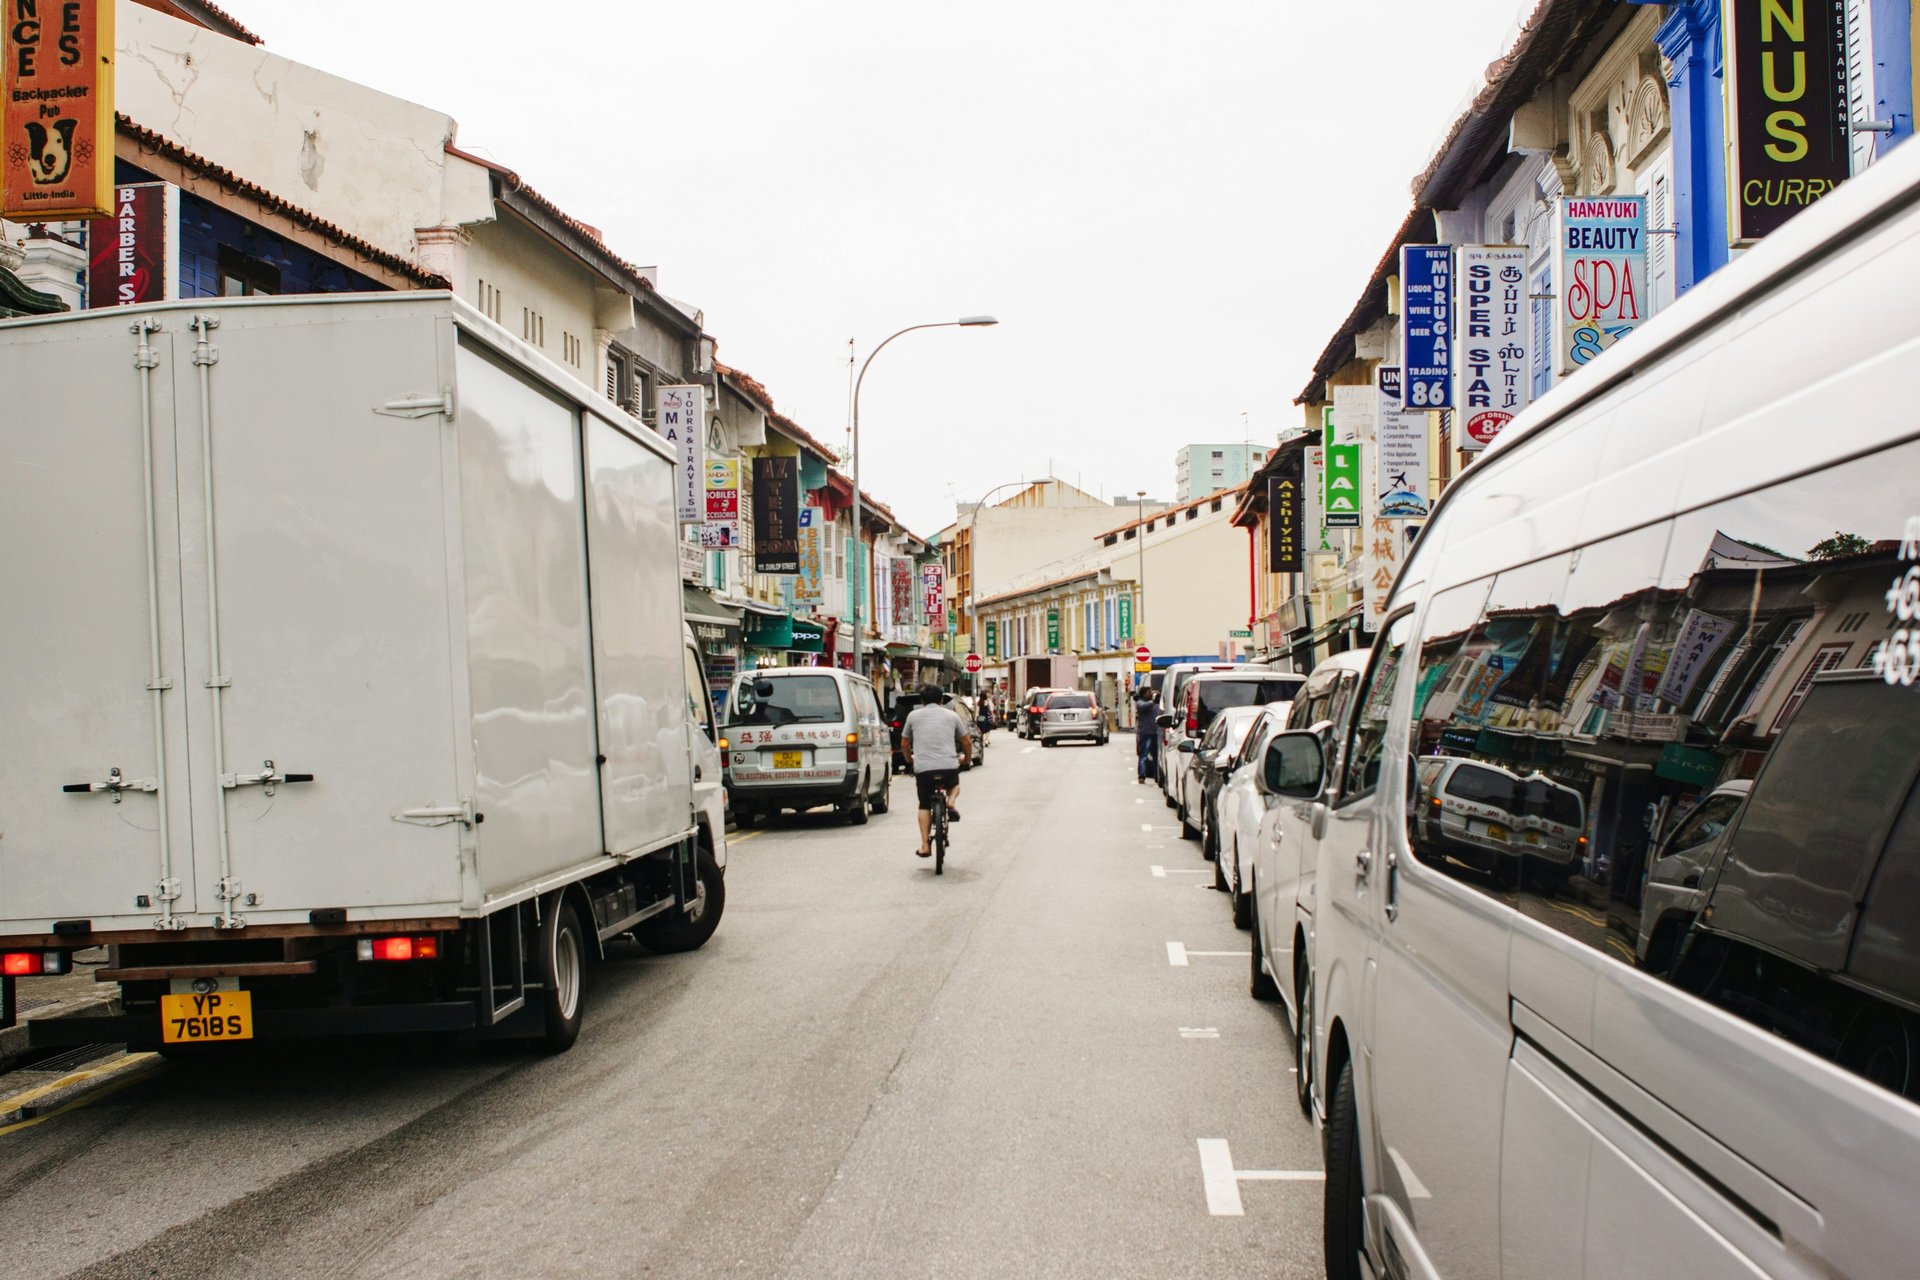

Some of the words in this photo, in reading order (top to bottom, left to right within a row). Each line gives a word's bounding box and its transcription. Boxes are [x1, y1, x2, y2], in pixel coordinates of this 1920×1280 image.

[1835, 1, 1847, 136] RESTAURANT
[1761, 0, 1808, 163] NUS
[12, 86, 89, 103] Backpacker
[39, 104, 60, 119] Pub
[23, 191, 48, 201] Little
[52, 189, 75, 199] India
[1568, 202, 1637, 218] HANAYUKI
[119, 188, 136, 277] BARBER
[1568, 227, 1639, 250] BEAUTY
[1426, 250, 1448, 258] NEW
[118, 283, 136, 306] S
[1408, 285, 1431, 293] LIQUOR
[1568, 256, 1639, 320] SPA
[1409, 306, 1430, 315] WINE
[1469, 264, 1490, 338] SUPER
[1431, 260, 1449, 366] MURUGAN
[1410, 328, 1430, 337] BEER
[1408, 367, 1448, 376] TRADING
[1468, 348, 1490, 408] STAR
[1411, 381, 1445, 406] 86
[686, 391, 695, 433] TOURS
[686, 436, 695, 445] &
[687, 447, 696, 506] TRAVELS
[706, 511, 736, 519] CCESSORIES
[1278, 480, 1294, 562] Aashiyana
[964, 659, 983, 668] STOP
[193, 995, 221, 1015] YP
[171, 1016, 242, 1039] 7618S
